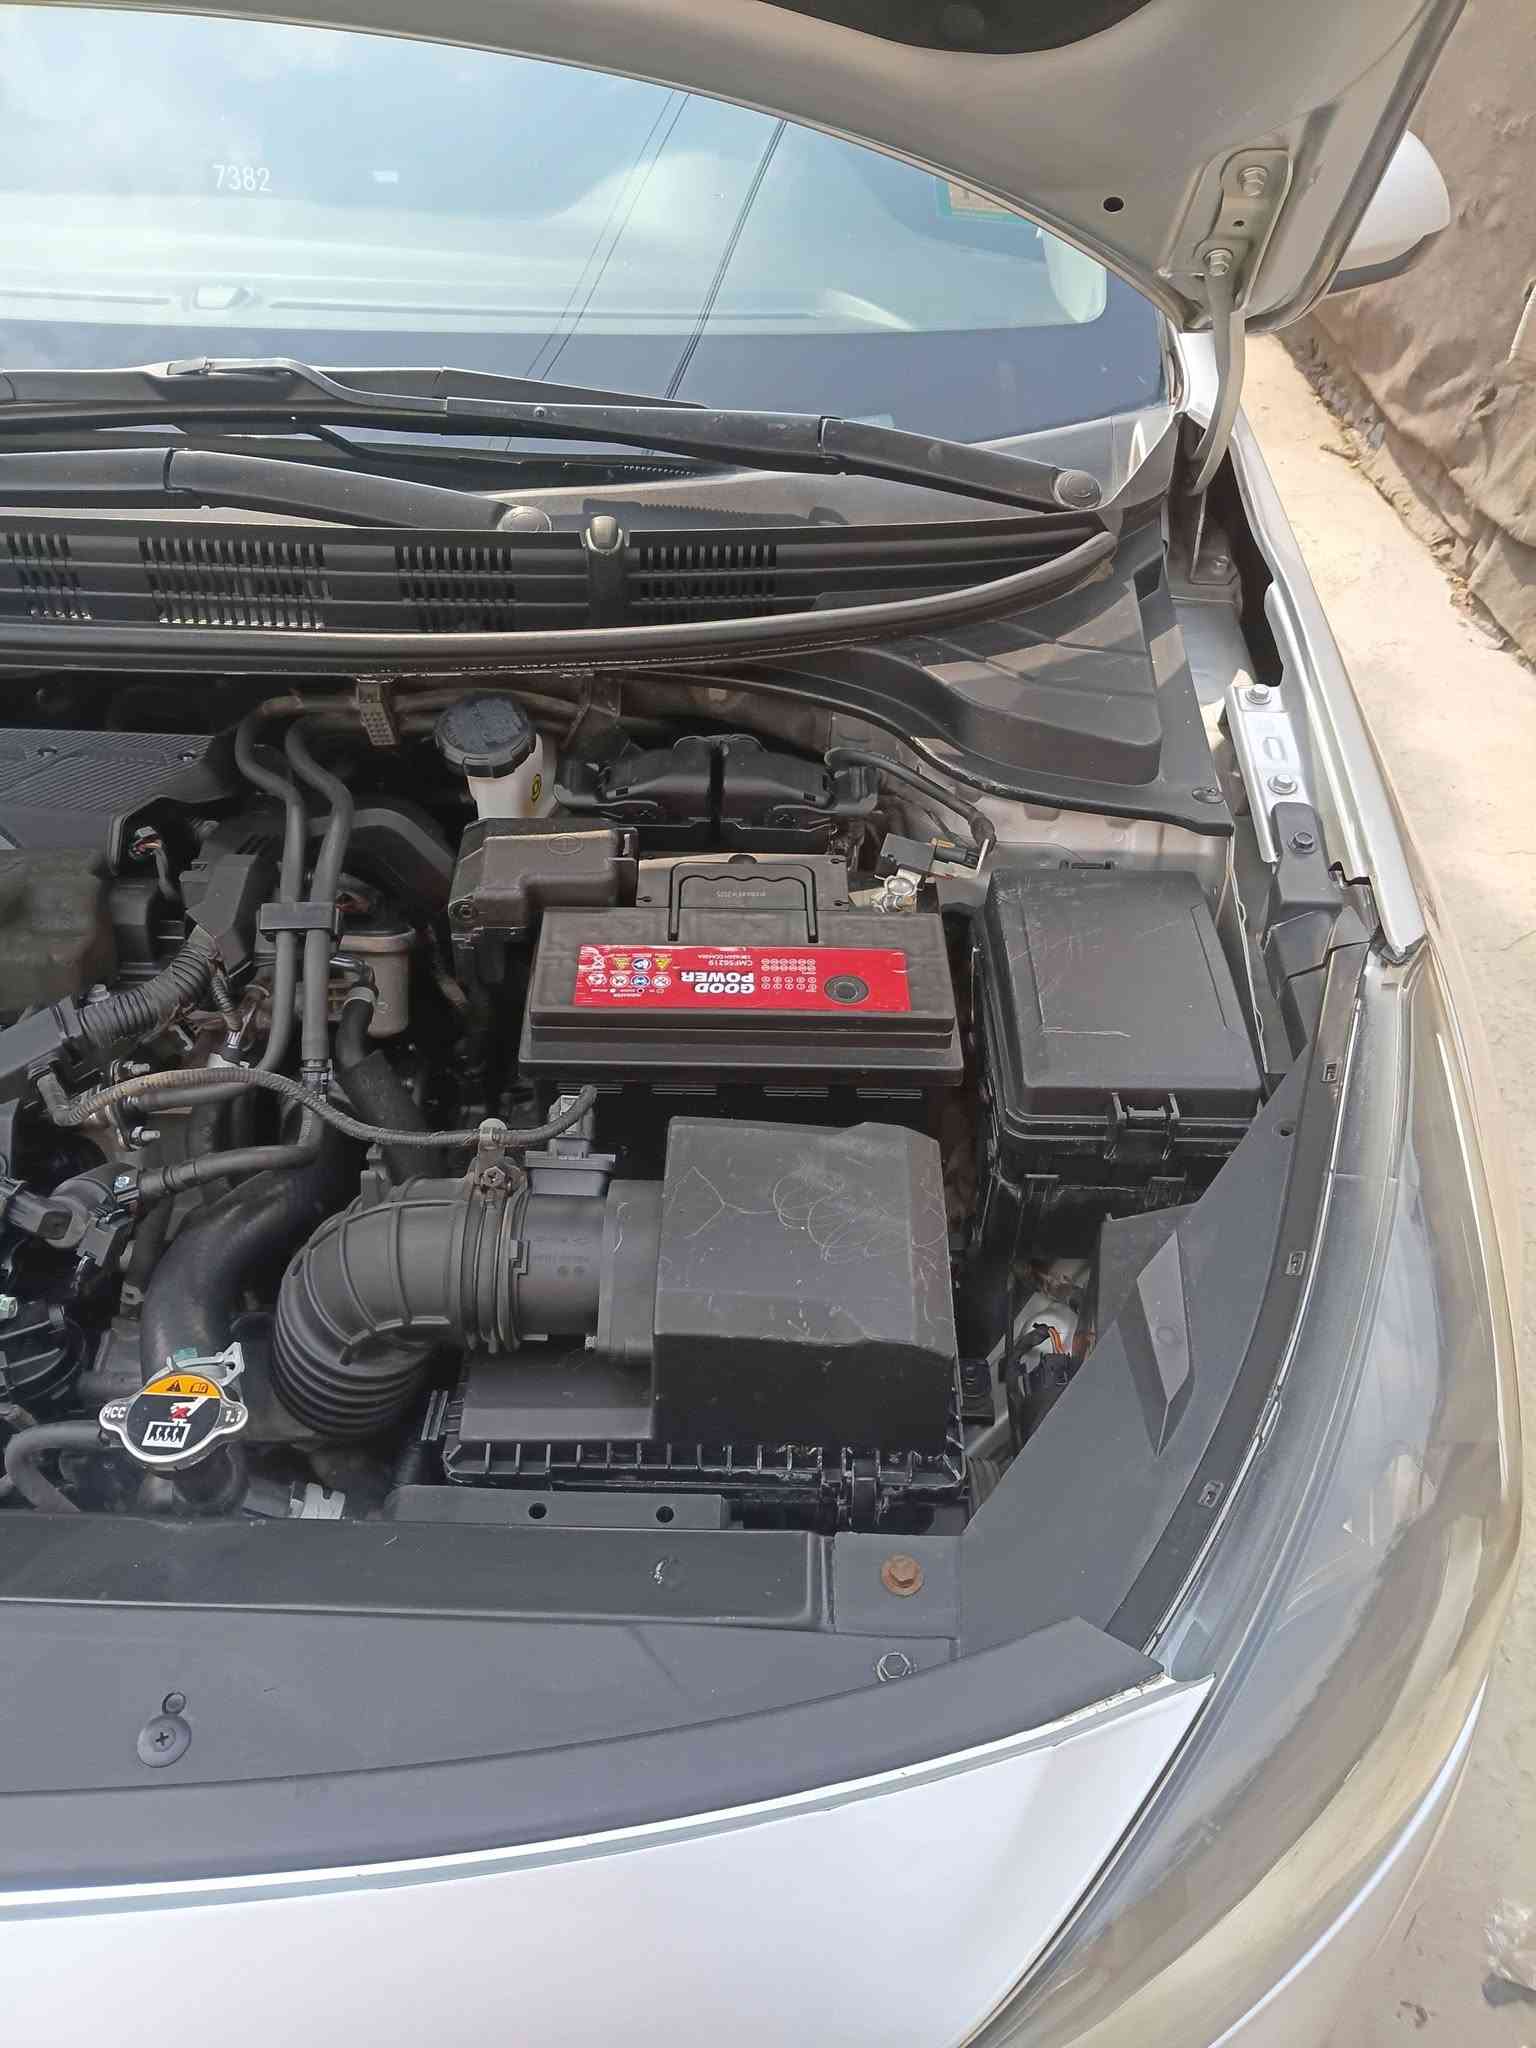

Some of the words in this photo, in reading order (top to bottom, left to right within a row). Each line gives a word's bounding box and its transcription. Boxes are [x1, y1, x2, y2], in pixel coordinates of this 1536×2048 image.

[212, 163, 273, 193] 7382
[680, 972, 755, 983] POWER
[694, 983, 755, 994] GOOD
[102, 1406, 127, 1419] HCC
[224, 1410, 242, 1423] 1.1
